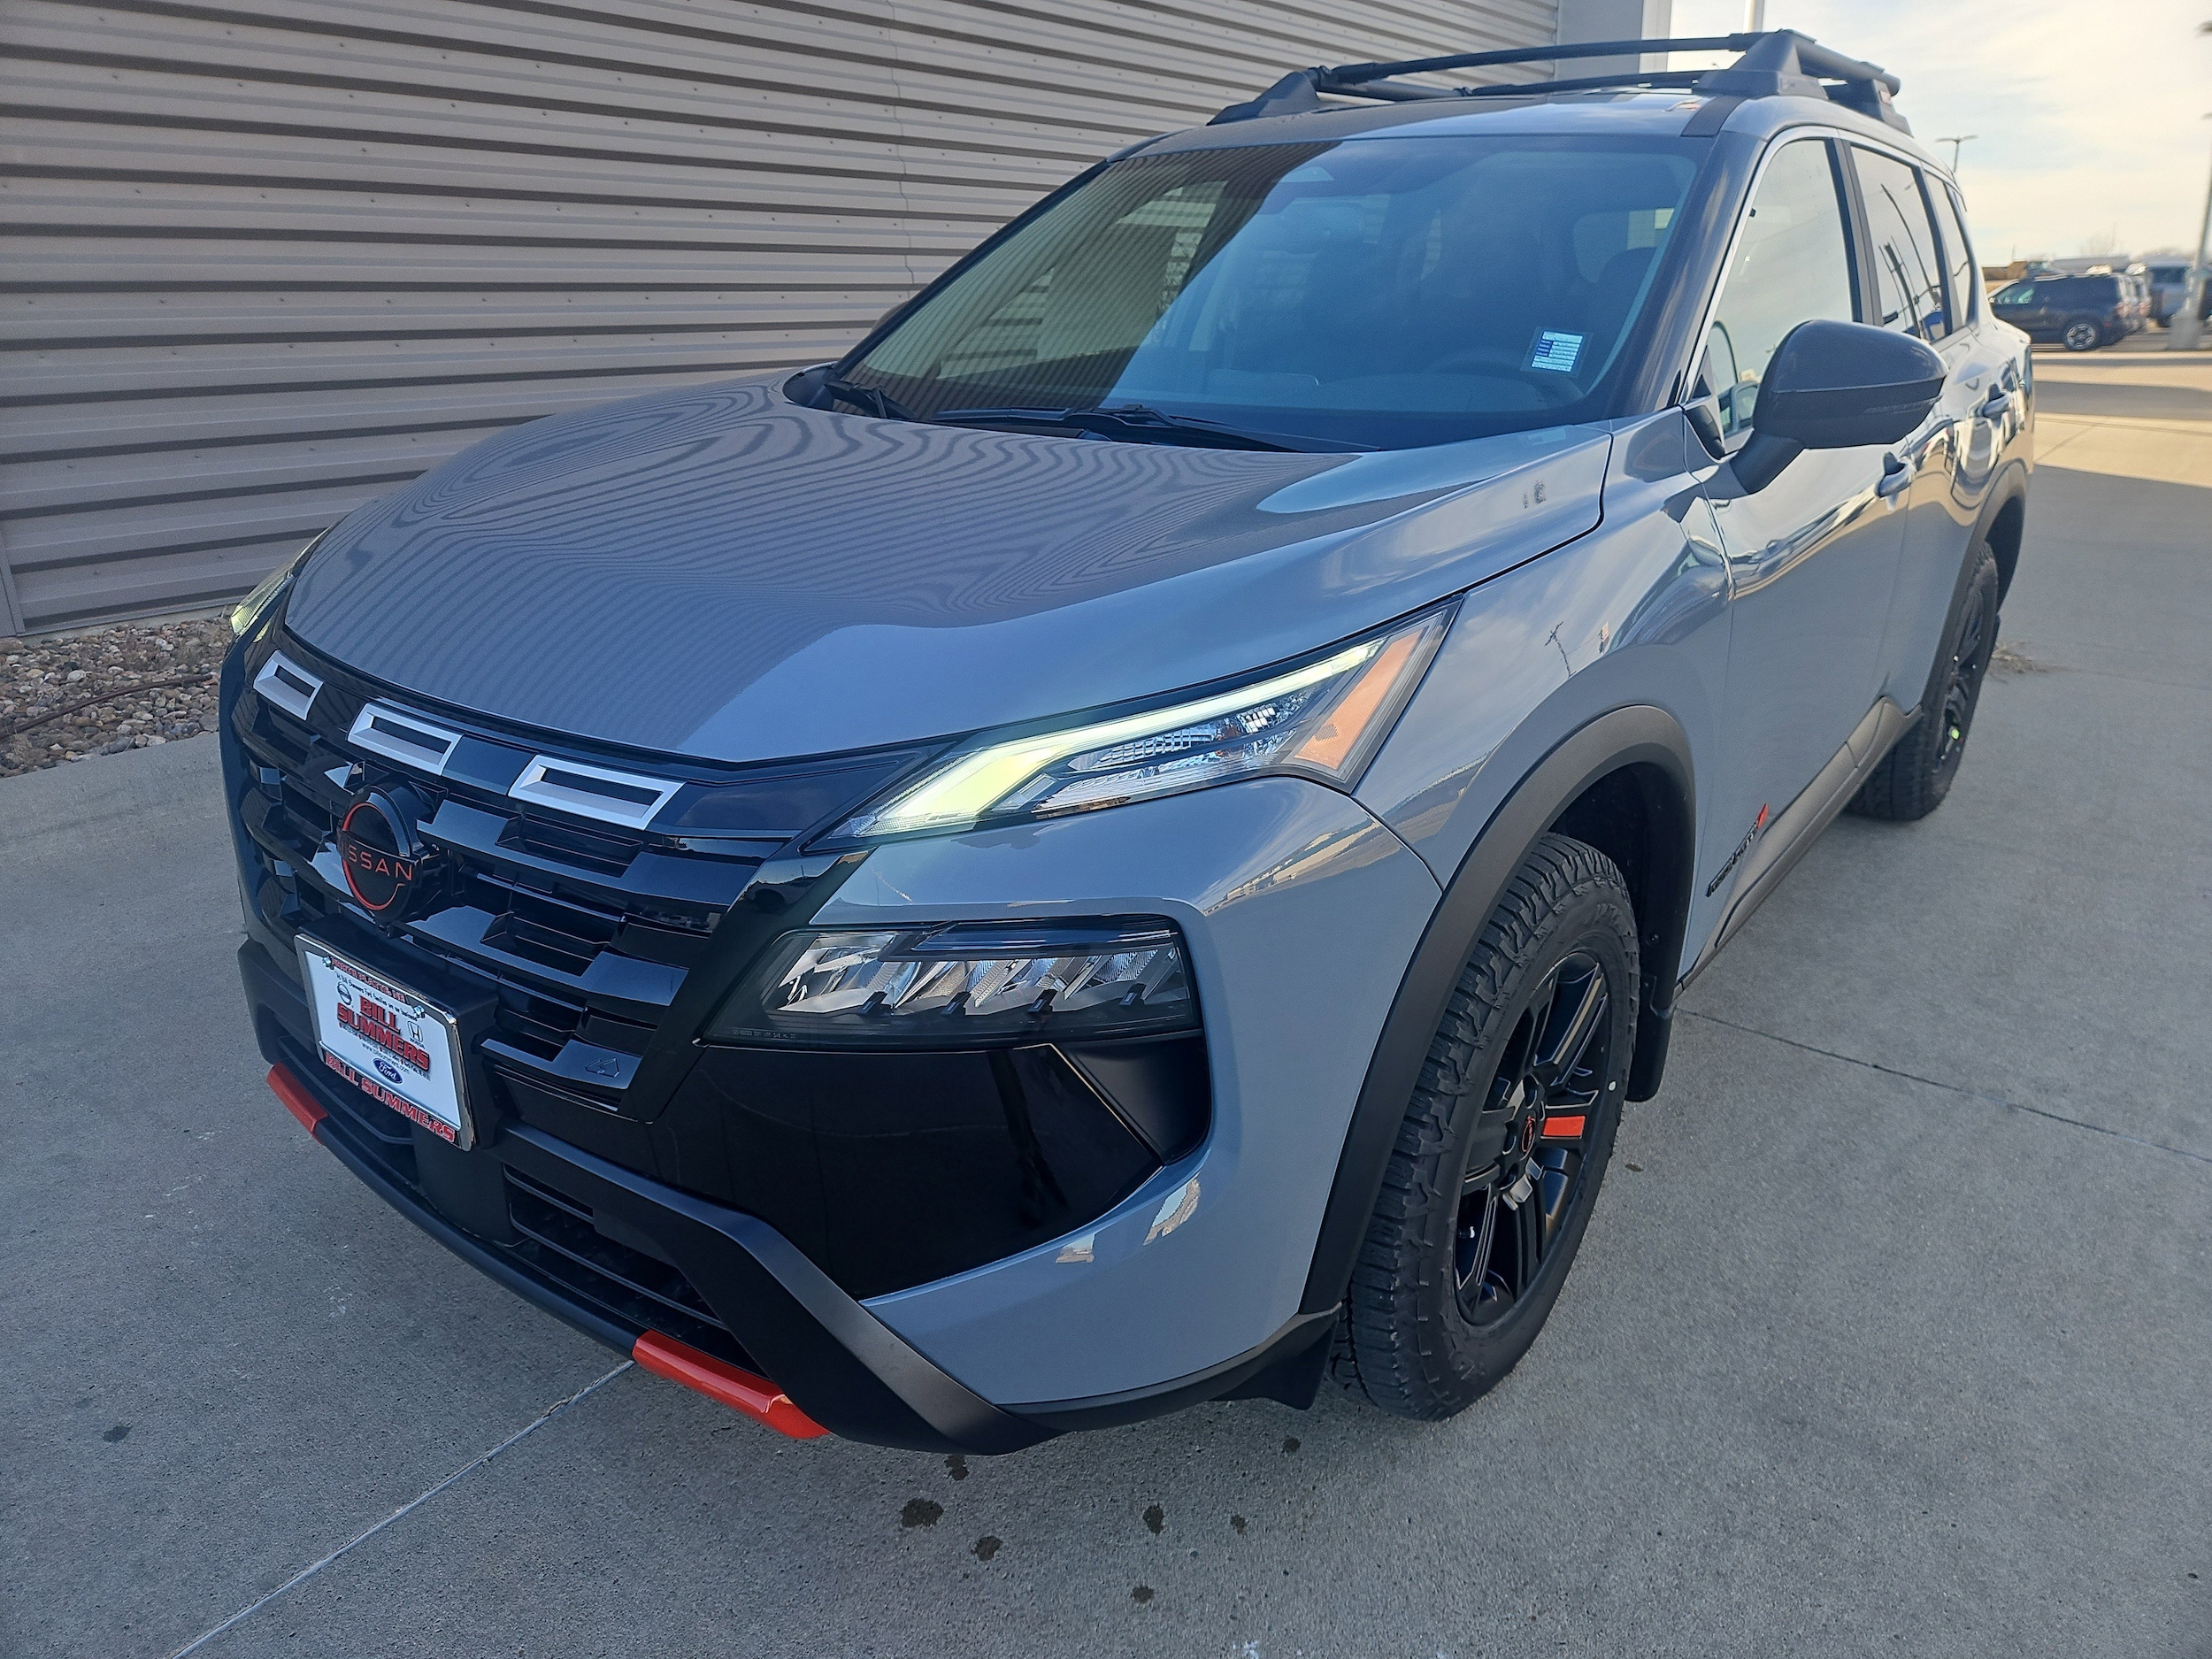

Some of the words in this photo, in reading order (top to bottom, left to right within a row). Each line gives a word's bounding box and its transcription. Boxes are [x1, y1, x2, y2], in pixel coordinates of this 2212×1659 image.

[337, 1002, 431, 1071] SUMMERS
[359, 995, 401, 1033] BILL
[378, 1061, 397, 1080] Ford
[325, 1052, 359, 1087] BILL
[361, 1076, 456, 1143] SUMMERS
